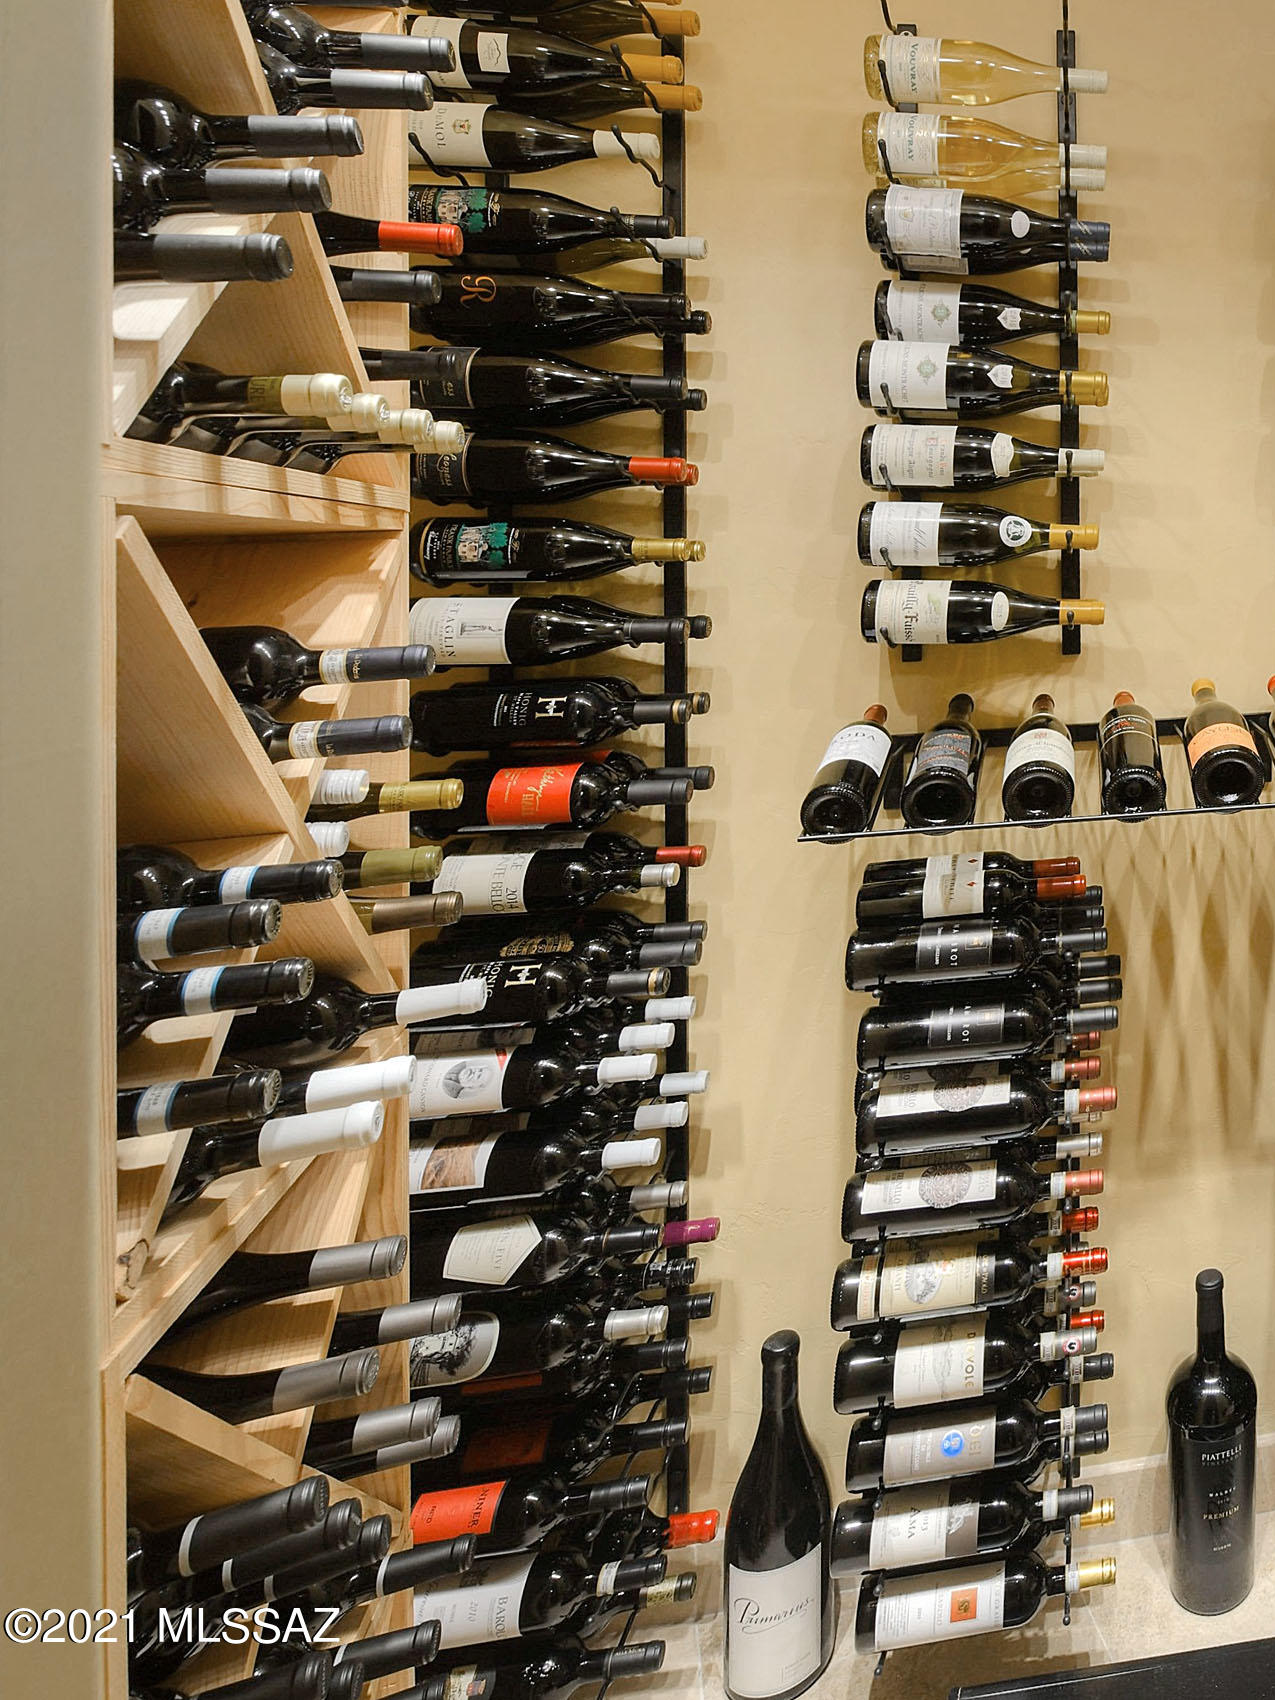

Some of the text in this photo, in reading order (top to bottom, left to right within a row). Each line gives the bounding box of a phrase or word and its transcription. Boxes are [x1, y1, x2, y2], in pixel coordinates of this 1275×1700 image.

[910, 42, 920, 95] VOUVRAY
[444, 603, 462, 657] STAGLIN
[518, 692, 533, 727] HONIG
[488, 880, 503, 913] BELLO
[504, 886, 517, 912] 2014
[1201, 1444, 1243, 1462] PIATTELLI
[470, 1487, 489, 1529] NINER
[1202, 1505, 1240, 1521] PREMIUM
[734, 1597, 810, 1634] Primarius
